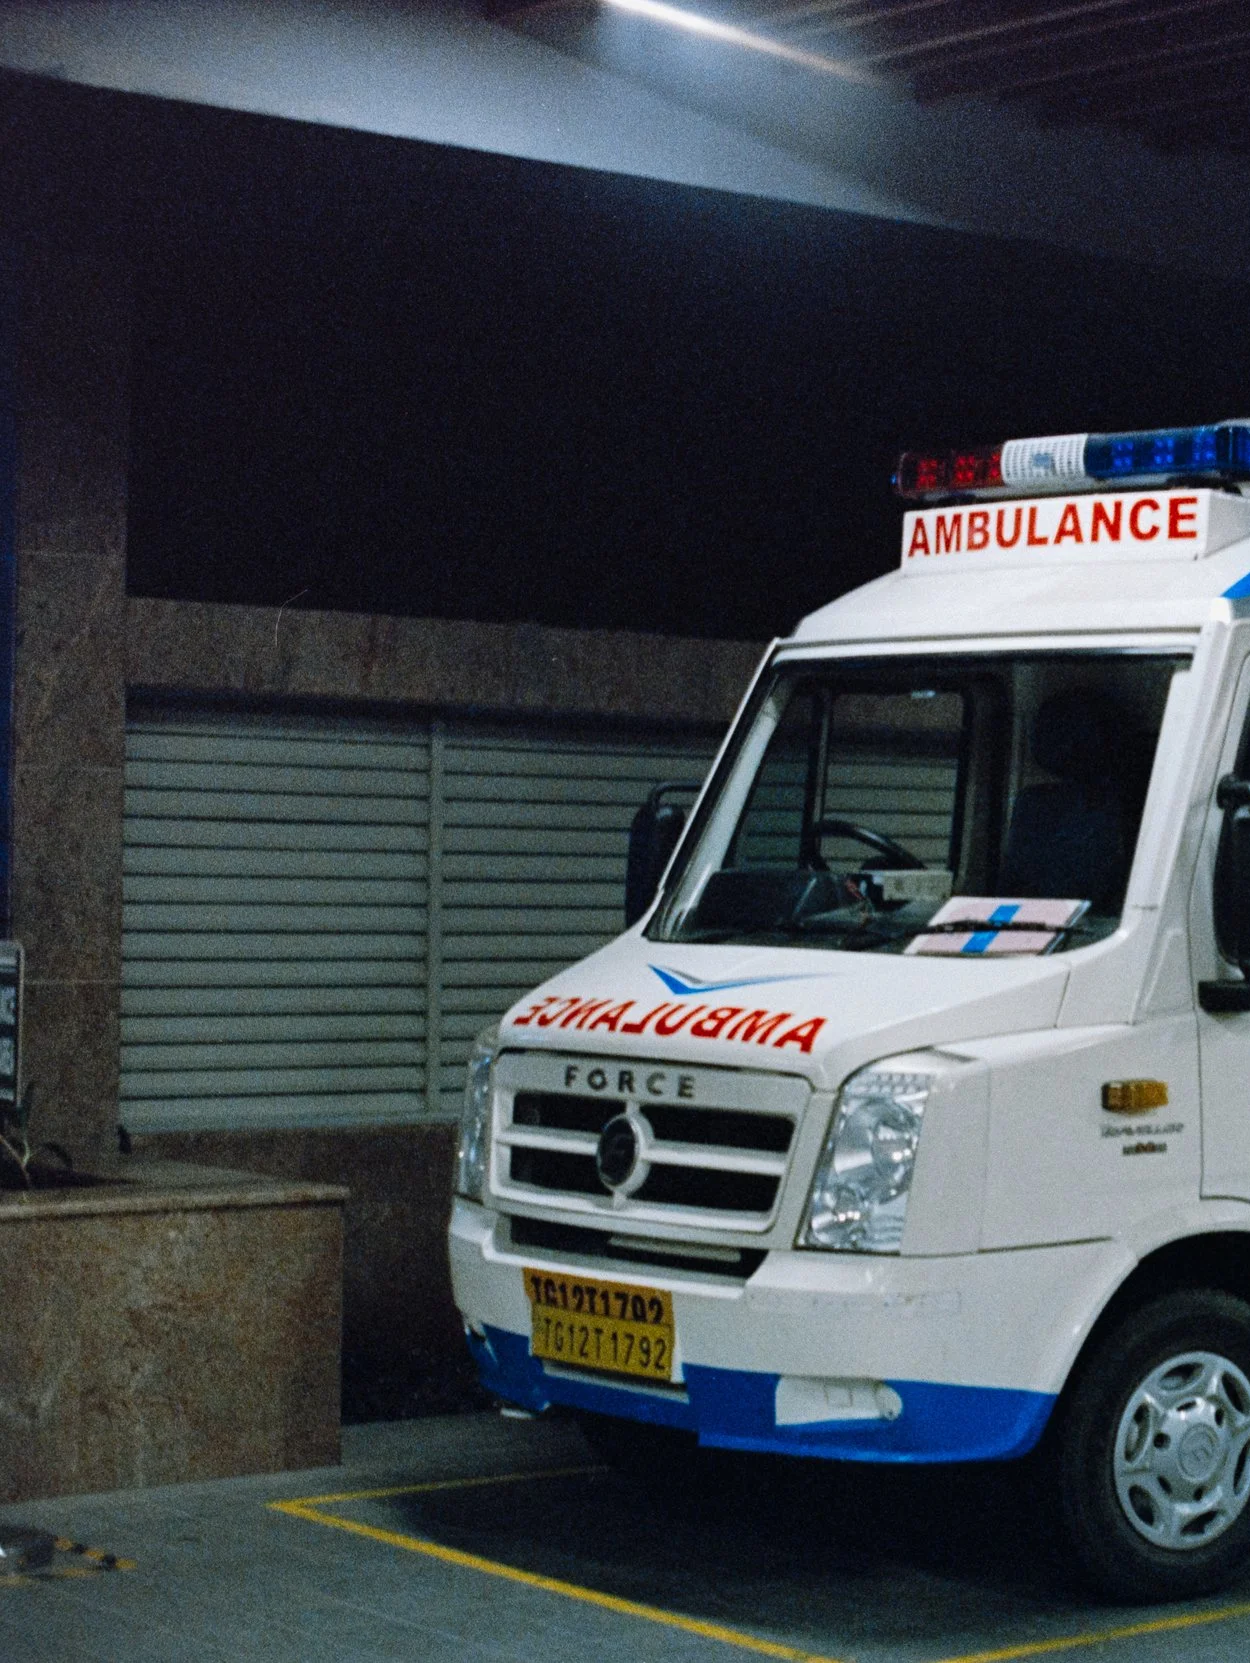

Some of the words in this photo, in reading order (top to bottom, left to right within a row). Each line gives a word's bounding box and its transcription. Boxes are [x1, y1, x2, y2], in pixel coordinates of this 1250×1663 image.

[908, 497, 1198, 558] AMBULANCE
[564, 1065, 695, 1097] FORCE
[544, 1317, 667, 1369] TG12T1792
